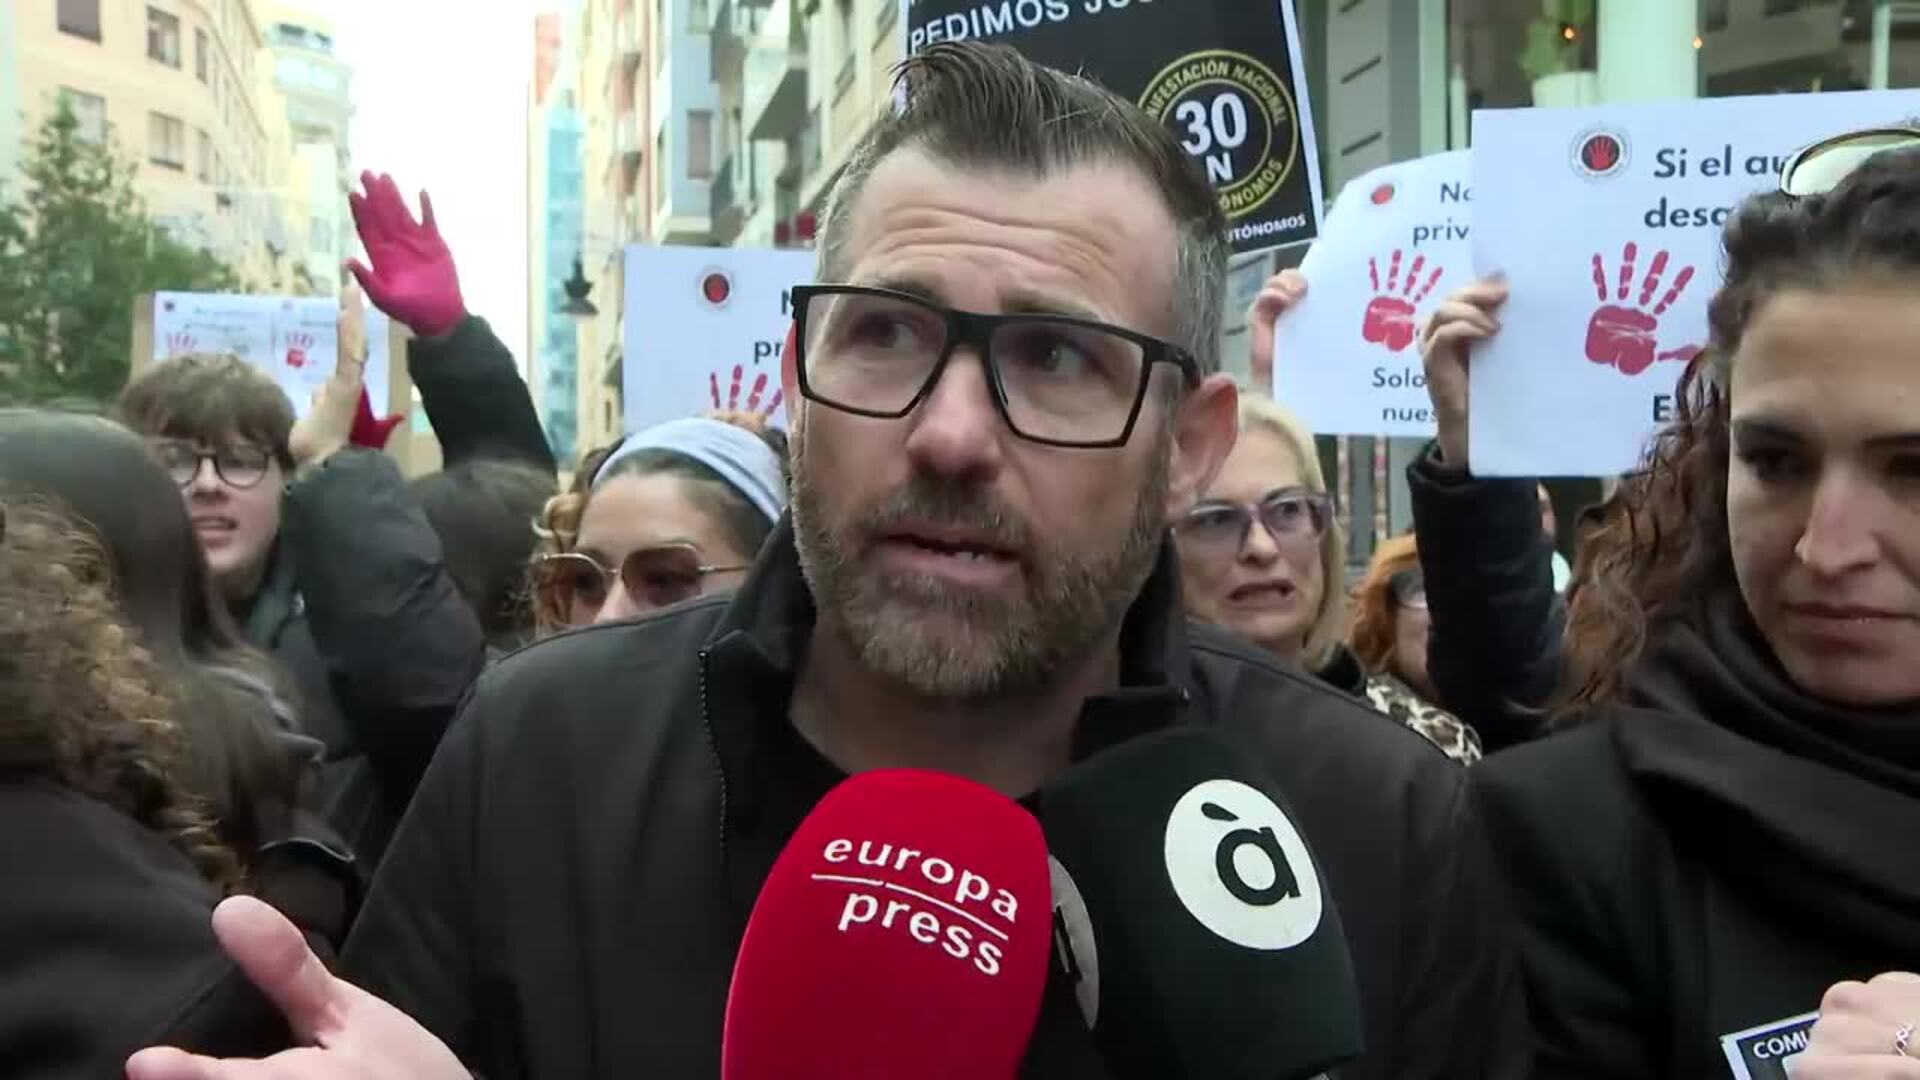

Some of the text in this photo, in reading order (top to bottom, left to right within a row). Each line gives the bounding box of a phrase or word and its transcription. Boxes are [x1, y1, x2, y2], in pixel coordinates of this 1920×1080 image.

[910, 0, 1069, 57] PEDIMOS
[1175, 92, 1247, 155] 30
[1232, 65, 1287, 127] NACIONAL
[1205, 152, 1234, 184] N
[1653, 147, 1687, 178] Si
[1700, 144, 1732, 177] el
[1412, 217, 1470, 248] priv
[823, 837, 1019, 924] europa
[838, 890, 1003, 977] press
